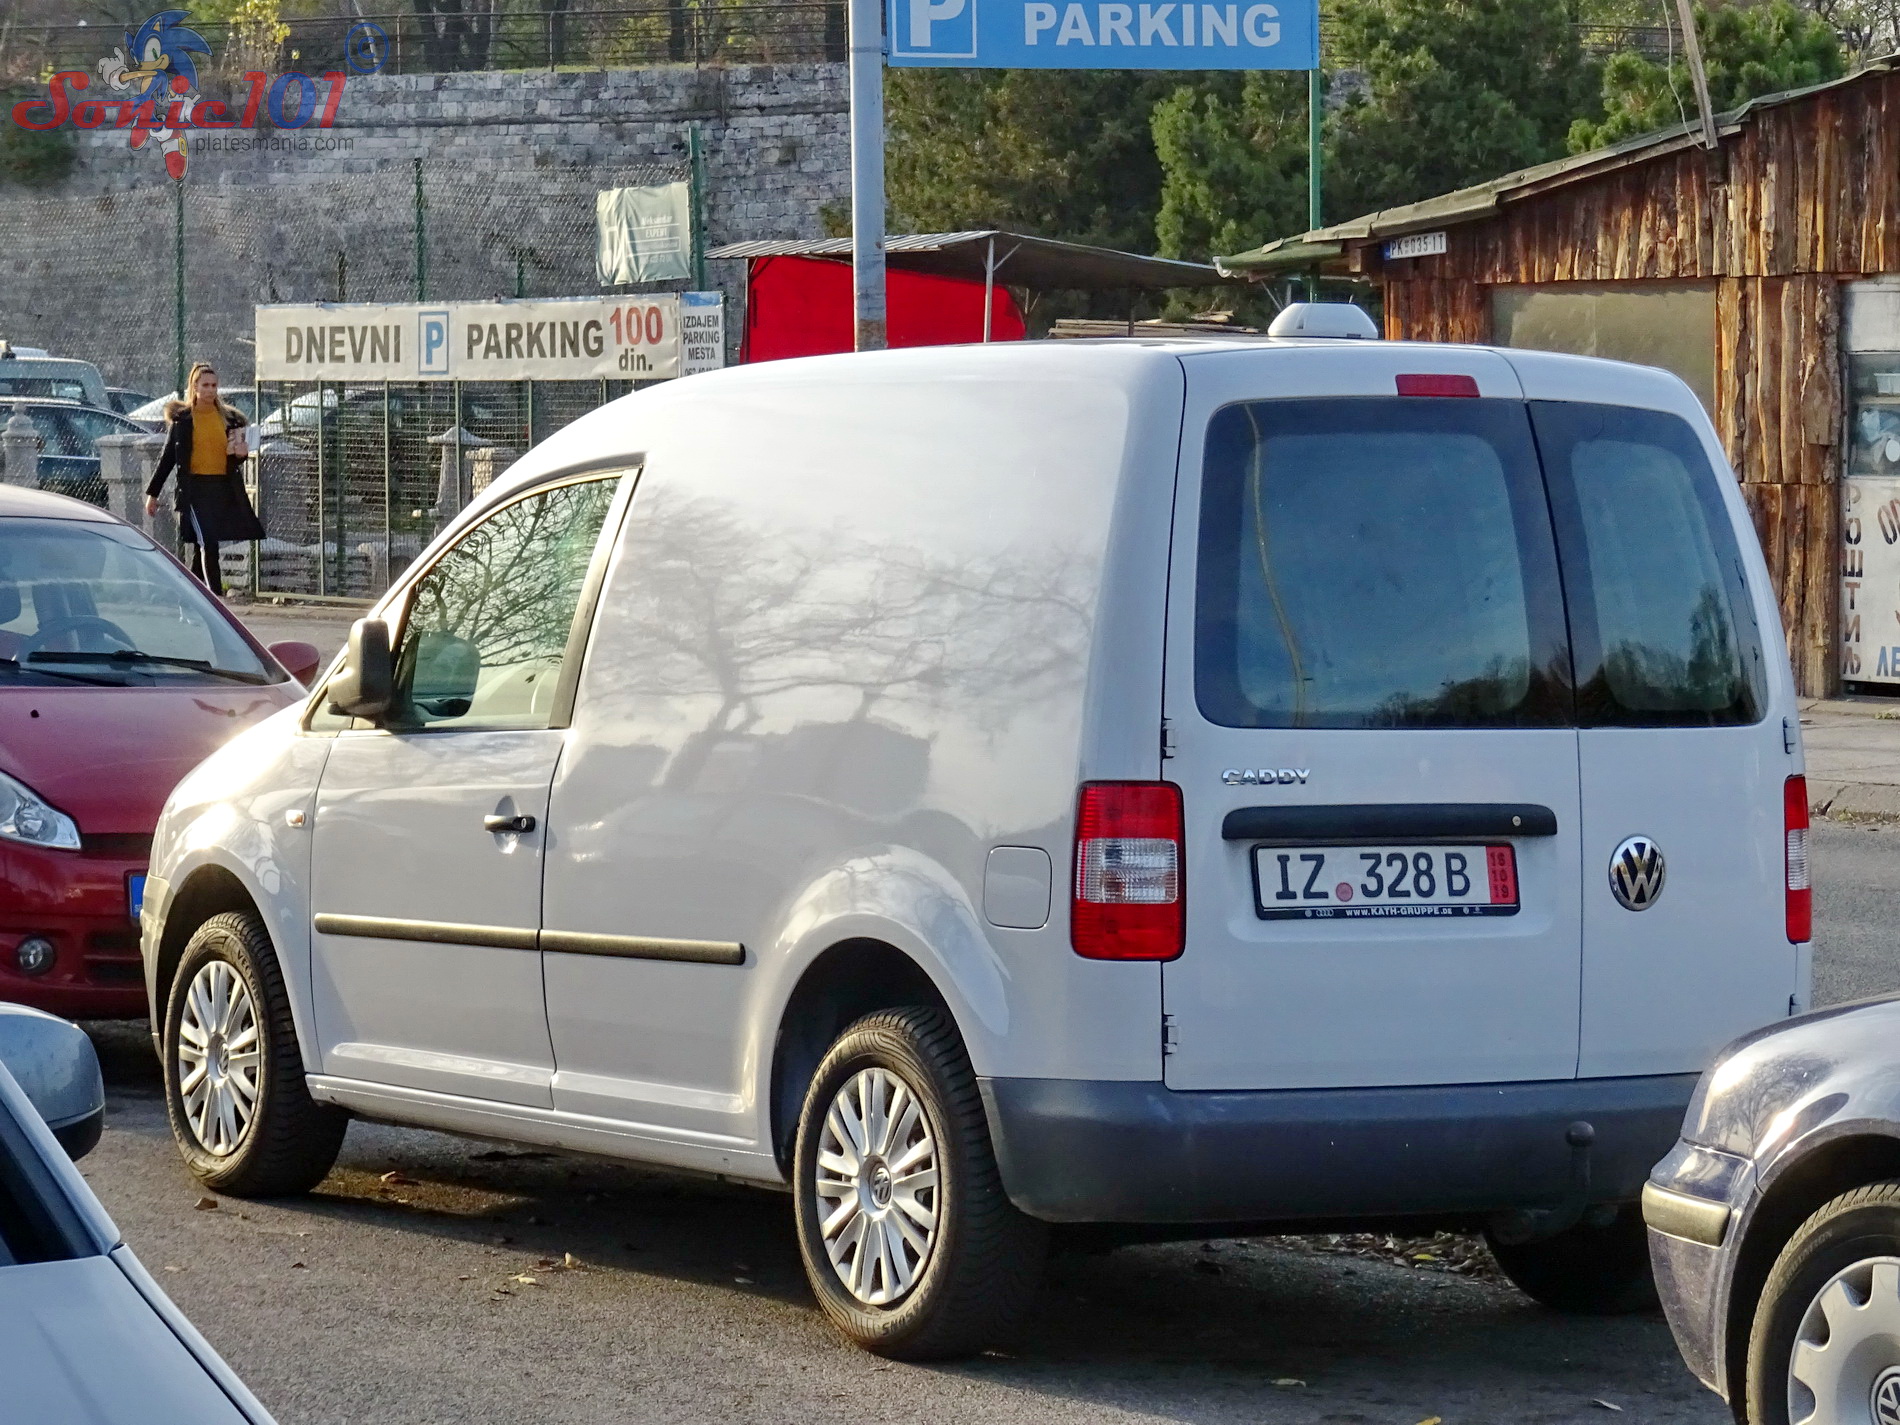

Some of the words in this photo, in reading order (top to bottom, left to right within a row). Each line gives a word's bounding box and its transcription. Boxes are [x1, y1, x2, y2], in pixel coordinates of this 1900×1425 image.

[909, 0, 963, 48] P
[1023, 2, 1282, 48] PARKING
[609, 306, 664, 346] 100
[683, 315, 719, 328] IZDAJEM
[285, 324, 401, 364] DNEVNI
[425, 321, 445, 366] P
[466, 319, 604, 361] PARKING
[682, 331, 720, 345] PARKING
[618, 348, 654, 372] din.
[687, 347, 716, 361] MESTA
[1221, 767, 1312, 786] CADDY
[1275, 853, 1330, 901] IZ
